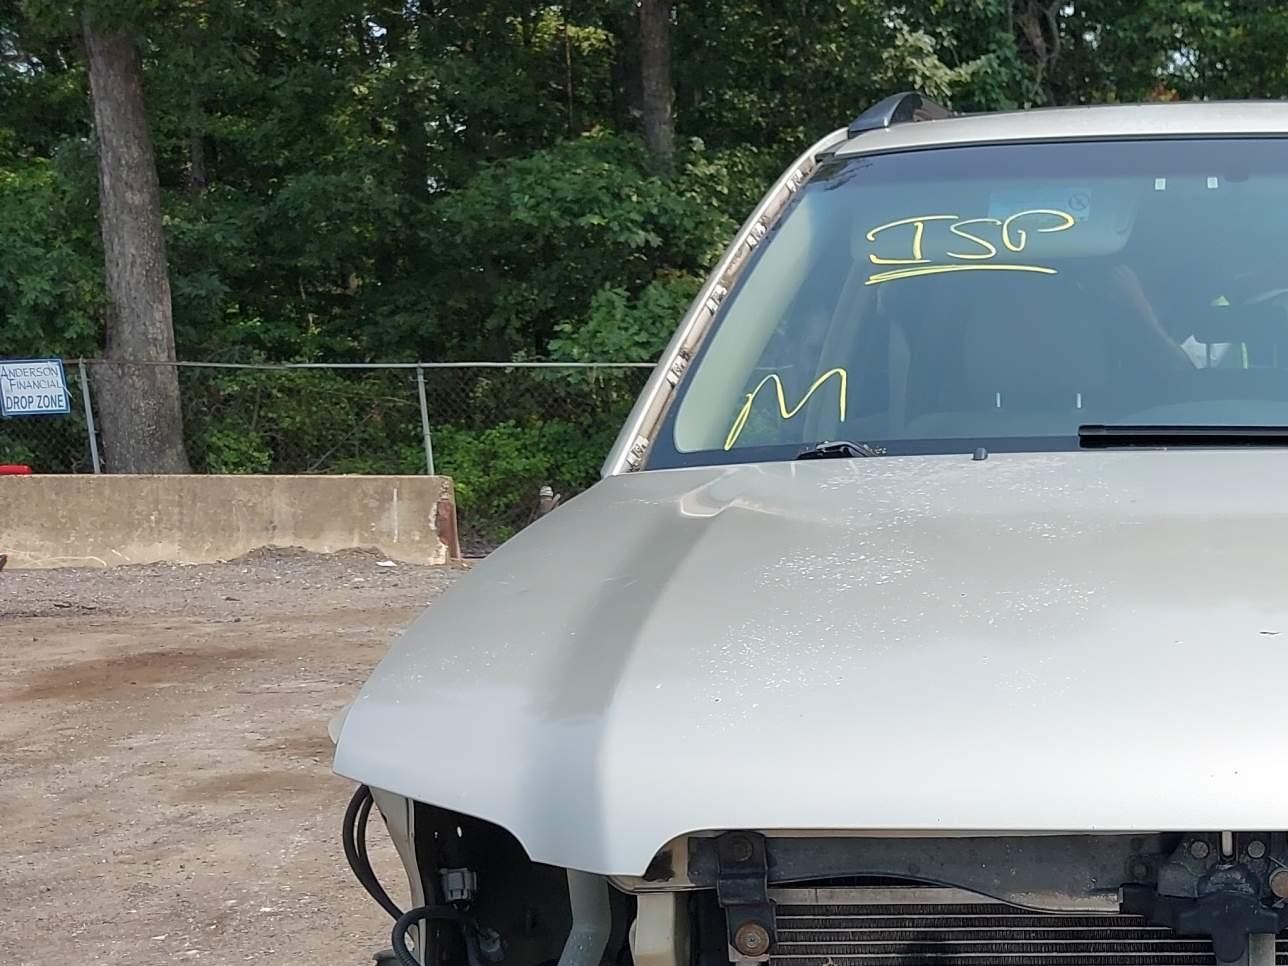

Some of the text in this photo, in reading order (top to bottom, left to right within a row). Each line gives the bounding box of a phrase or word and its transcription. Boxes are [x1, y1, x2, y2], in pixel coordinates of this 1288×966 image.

[1, 366, 59, 378] ANDERSON
[9, 379, 64, 392] FINANCIAL
[6, 394, 64, 410] DROP ZONE
